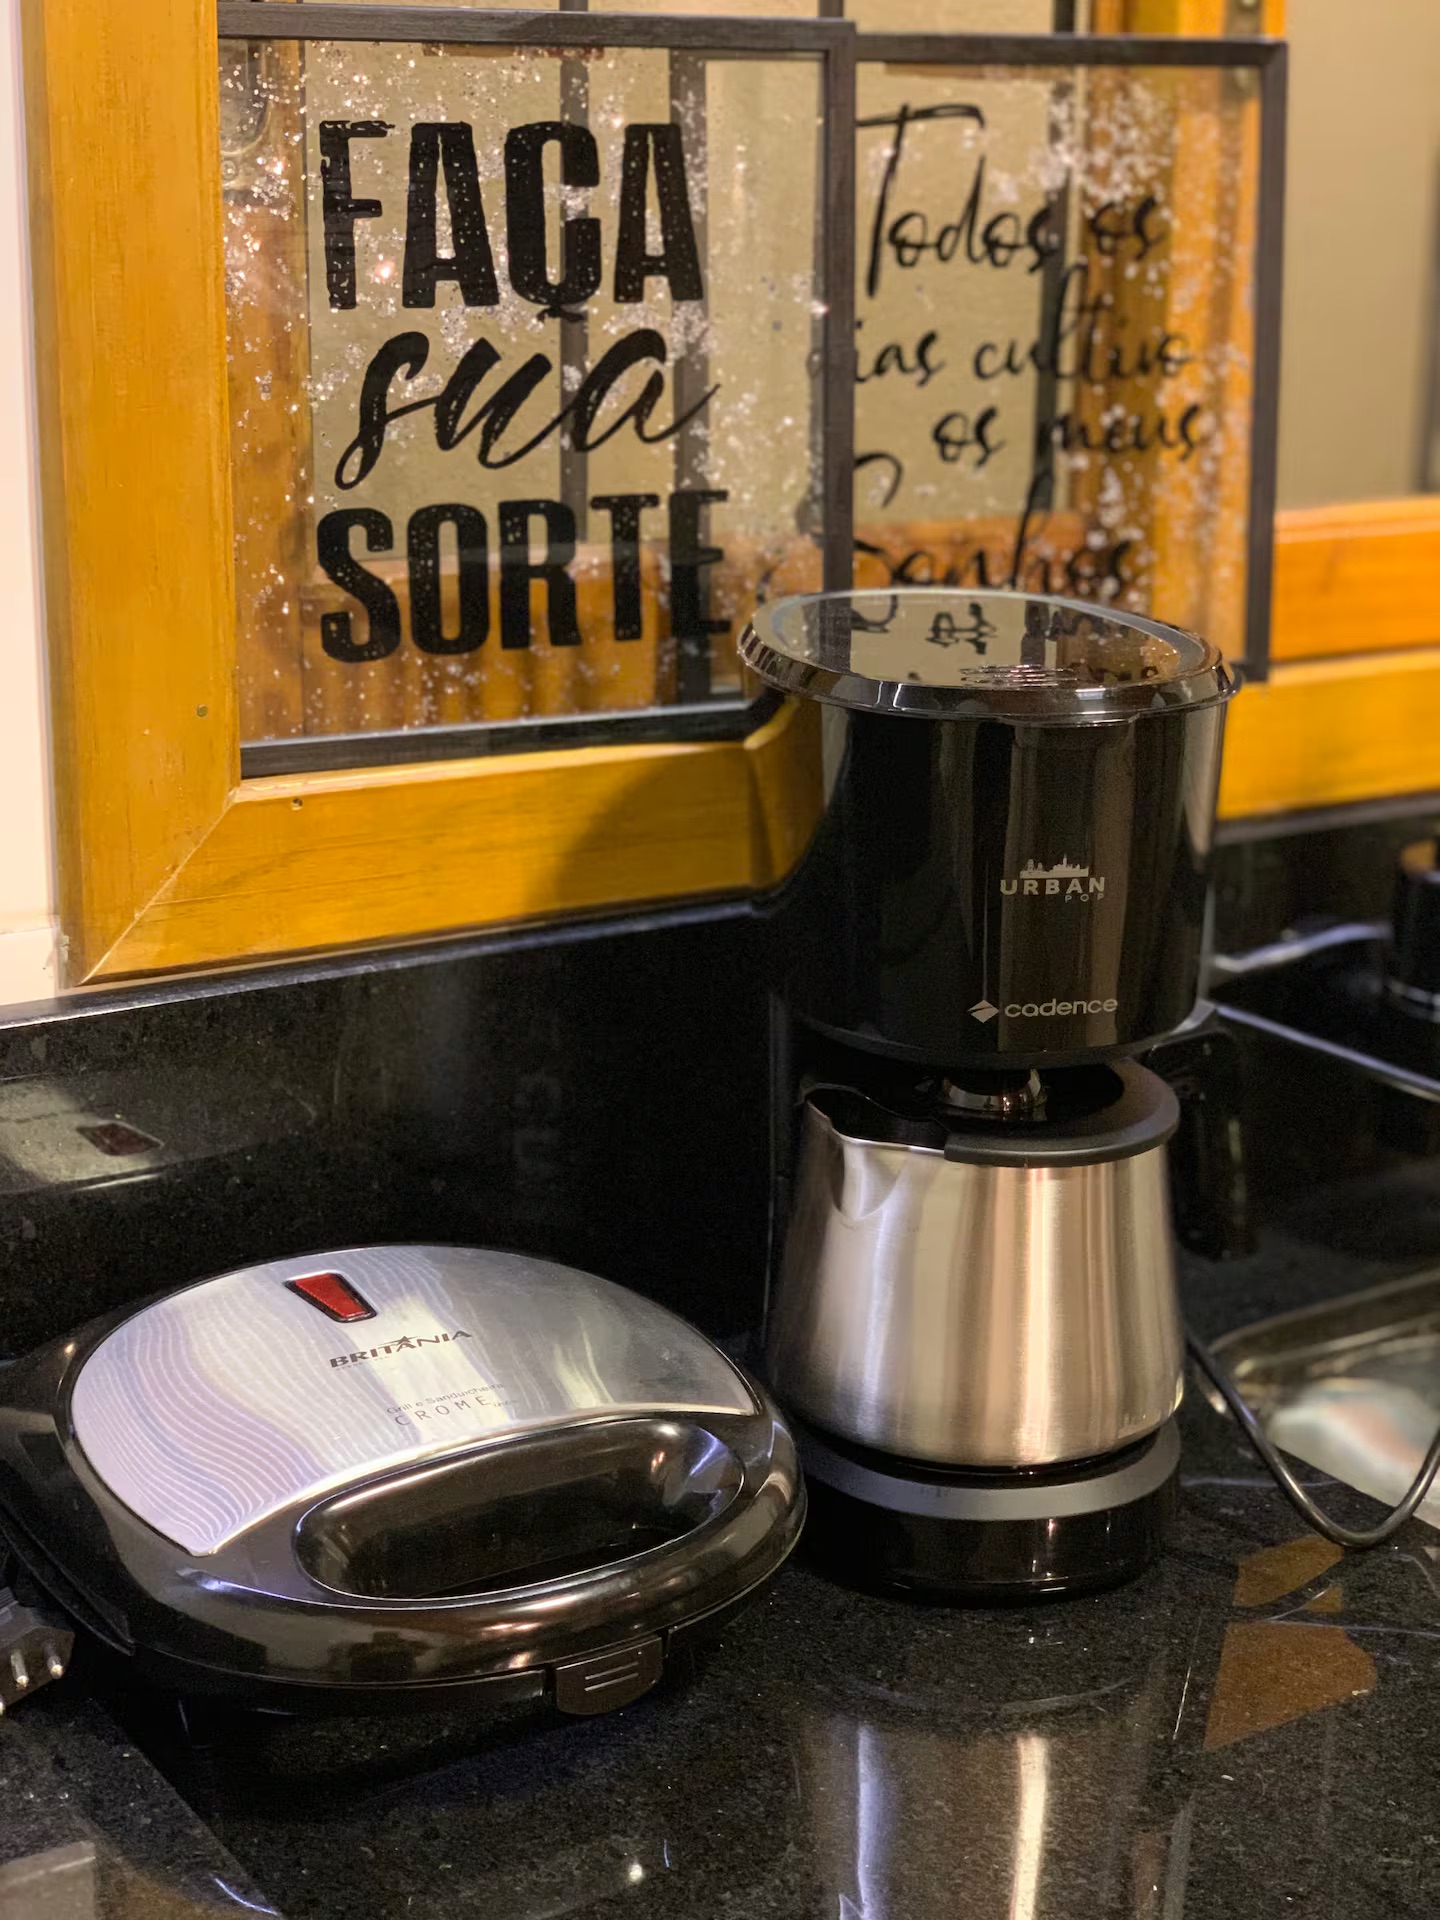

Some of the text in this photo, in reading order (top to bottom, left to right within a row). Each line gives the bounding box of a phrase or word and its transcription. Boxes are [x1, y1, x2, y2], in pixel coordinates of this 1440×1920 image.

[318, 119, 705, 323] FAÇA
[855, 102, 1060, 297] Todos
[853, 318, 945, 386] ias
[334, 328, 722, 491] sua
[932, 405, 1003, 467] os
[316, 489, 730, 664] SORTE
[1000, 876, 1106, 896] URBAN
[1064, 893, 1105, 904] POP
[1003, 998, 1118, 1018] cadence
[394, 1395, 492, 1426] CROME
